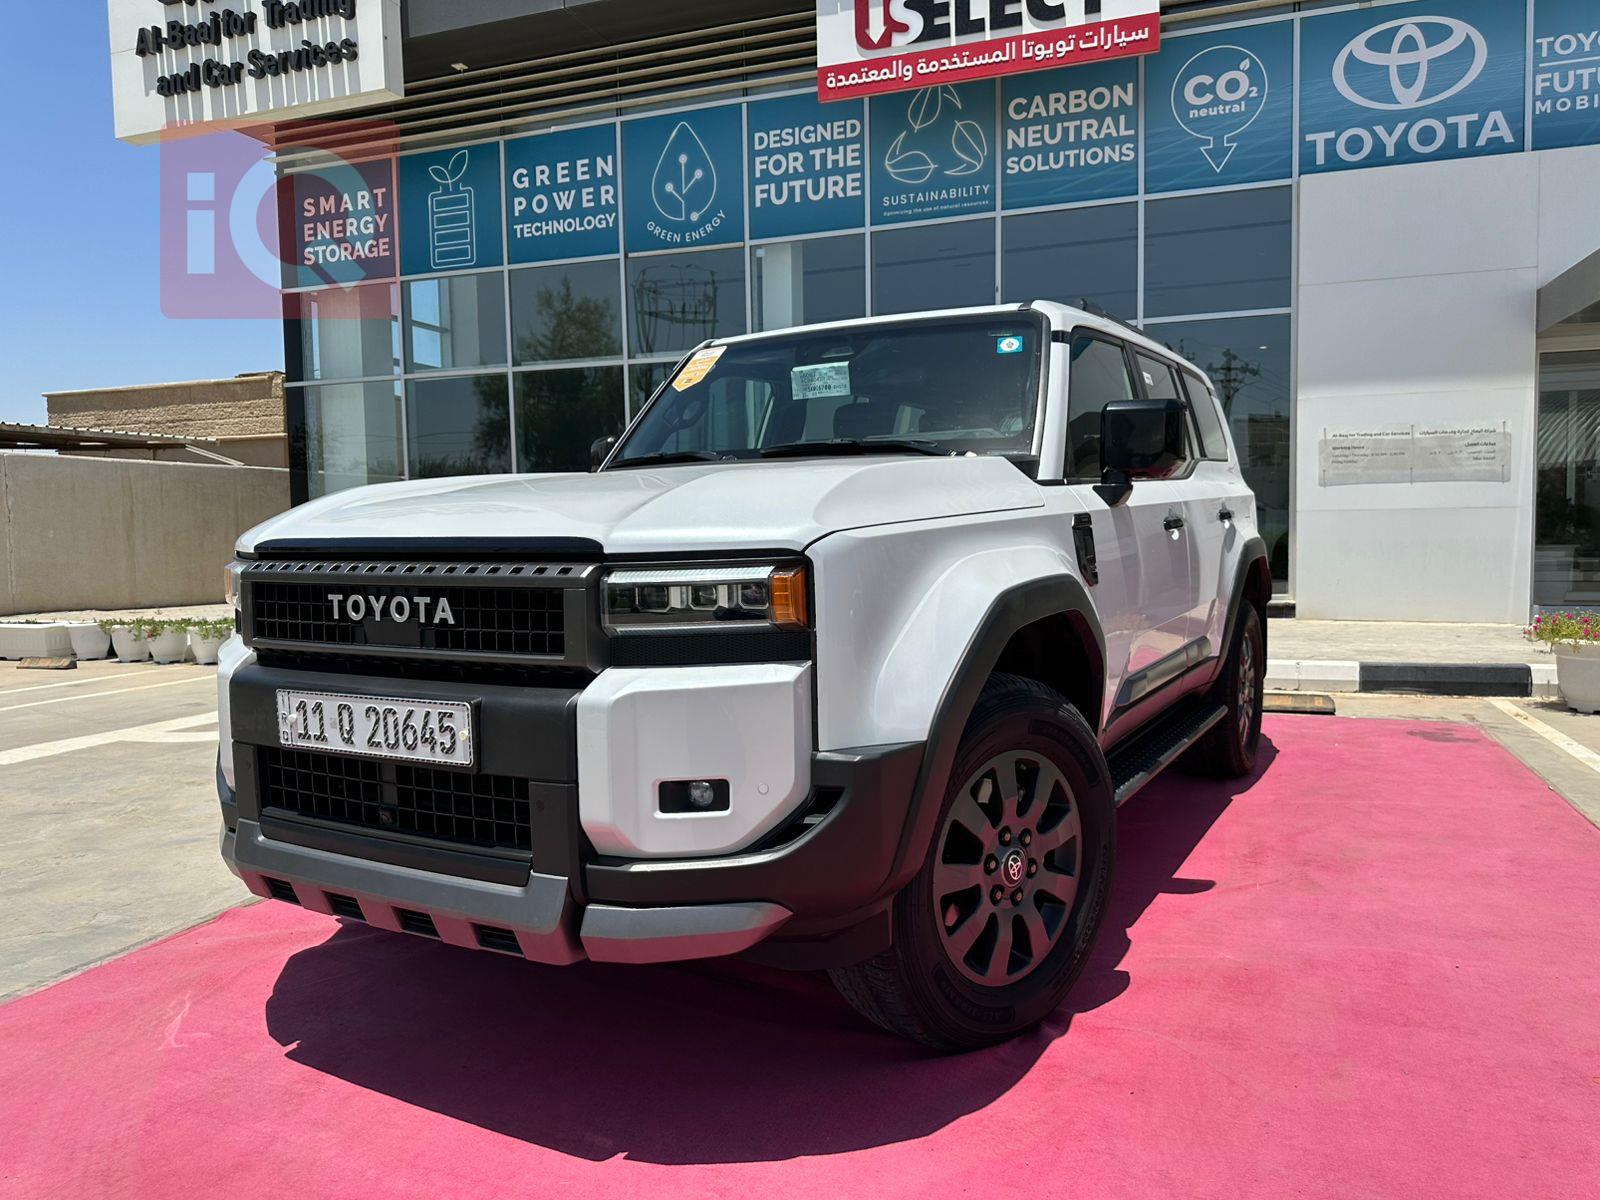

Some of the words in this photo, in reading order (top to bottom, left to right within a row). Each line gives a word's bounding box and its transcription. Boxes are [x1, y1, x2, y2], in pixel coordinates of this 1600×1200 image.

[136, 11, 221, 57] Al-Baaj
[221, 8, 258, 39] for
[262, 0, 356, 29] Trading
[1078, 24, 1149, 51] سيارات
[1535, 31, 1600, 57] TOY
[917, 41, 1016, 73] المستخدمة
[1022, 33, 1075, 61] تويوتا
[157, 63, 200, 97] and
[202, 58, 244, 88] Car
[248, 38, 358, 79] Services
[826, 59, 911, 89] والمعتمدة
[1535, 67, 1600, 96] FUT
[1008, 82, 1134, 121] CARBON
[1189, 101, 1246, 118] neutral
[1535, 94, 1599, 115] MOBI
[754, 119, 861, 150] DESIGNED
[1007, 115, 1135, 149] NEUTRAL
[1305, 110, 1514, 165] TOYOTA
[512, 155, 614, 189] GREEN
[755, 151, 804, 178] FOR
[810, 144, 861, 169] THE
[1007, 143, 1135, 175] SOLUTIONS
[303, 188, 386, 217] SMART
[514, 184, 615, 216] POWER
[755, 173, 862, 207] FUTURE
[882, 184, 990, 206] SUSTAINABILITY
[303, 213, 388, 242] ENERGY
[514, 213, 616, 239] TECHNOLOGY
[646, 221, 681, 243] GREEN
[685, 209, 726, 242] ENERGY
[303, 238, 390, 265] STORAGE
[328, 594, 455, 624] TOYOTA
[296, 700, 328, 742] 11
[337, 703, 354, 745] Q
[365, 705, 457, 755] 20645
